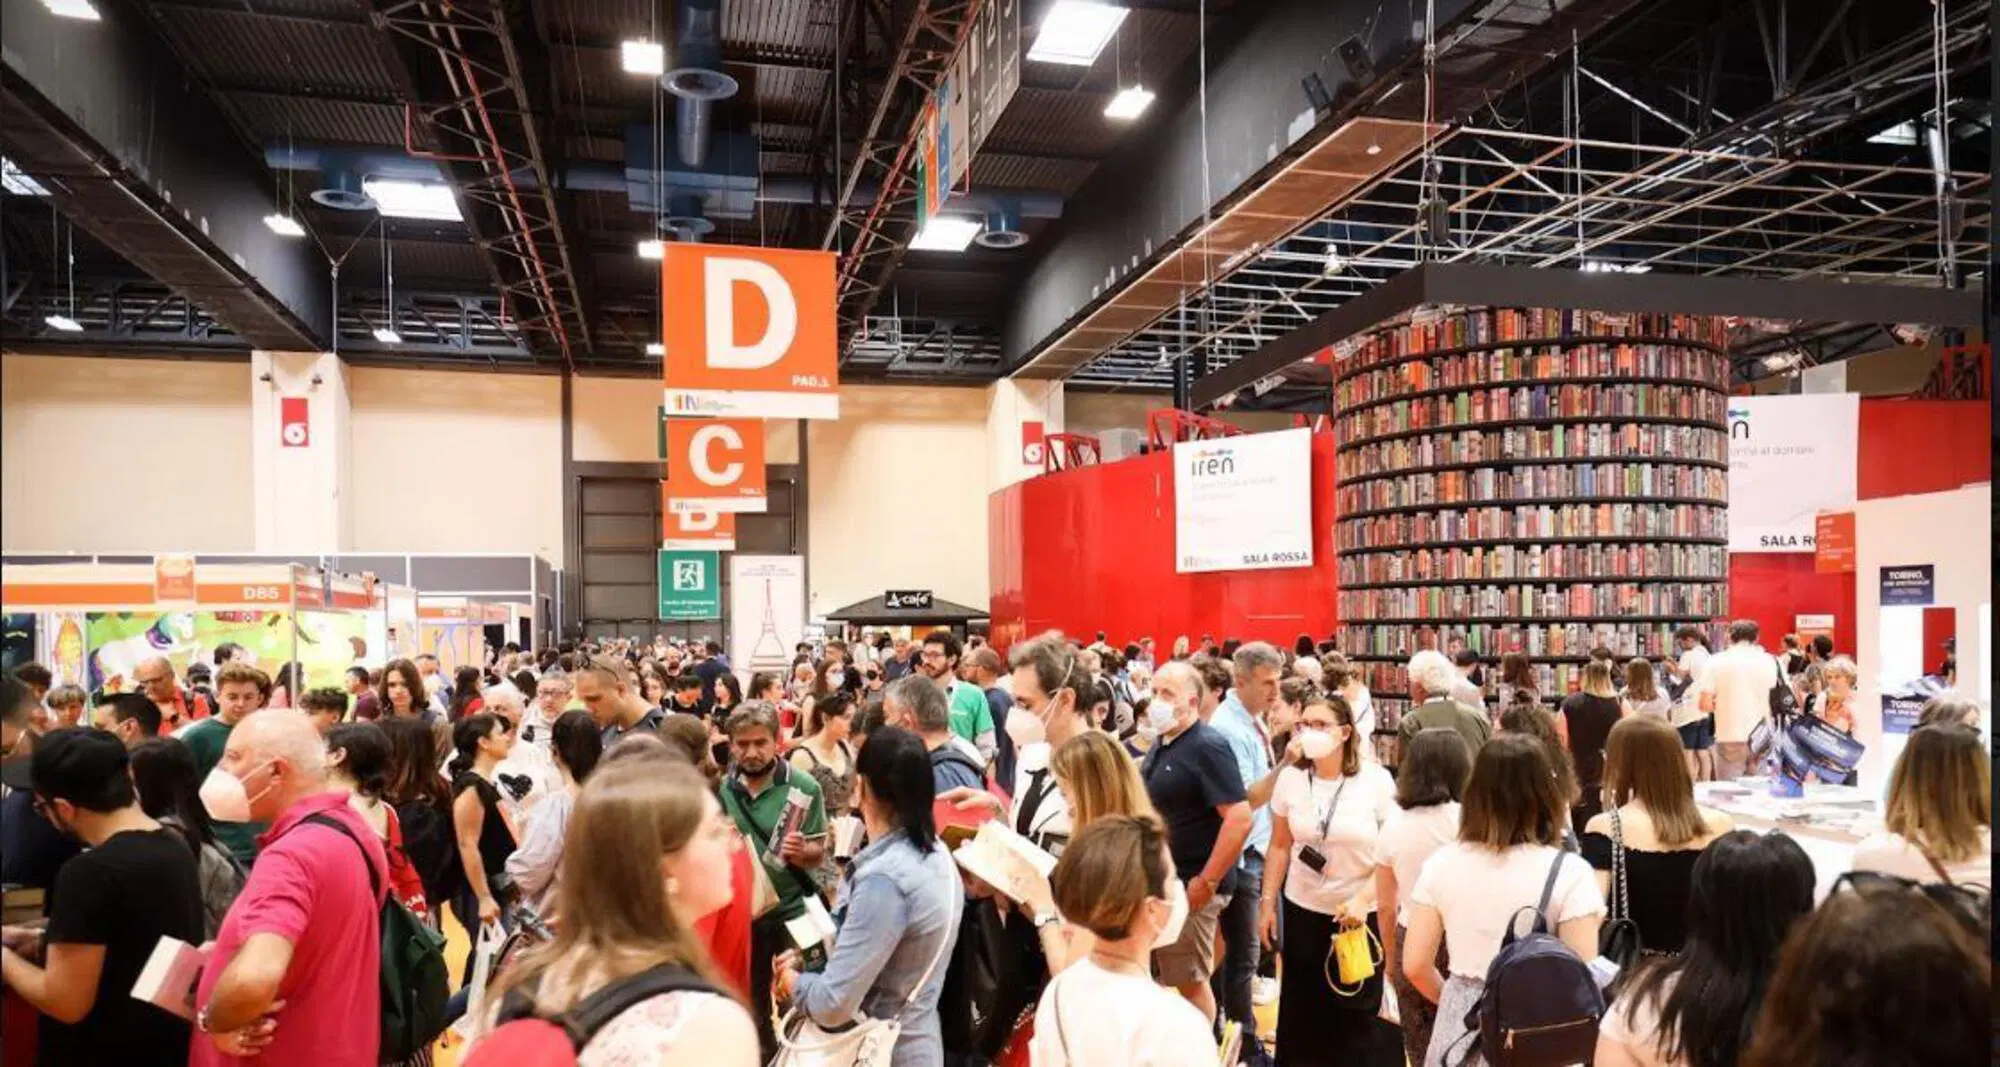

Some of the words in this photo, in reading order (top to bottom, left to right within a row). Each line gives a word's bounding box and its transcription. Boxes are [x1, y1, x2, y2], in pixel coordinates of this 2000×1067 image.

[704, 256, 798, 369] D
[689, 424, 745, 486] C
[1191, 456, 1235, 477] iren
[1760, 534, 1797, 547] SALA
[1802, 534, 1816, 546] R
[1243, 553, 1269, 565] SALA
[1271, 551, 1309, 563] ROSSA
